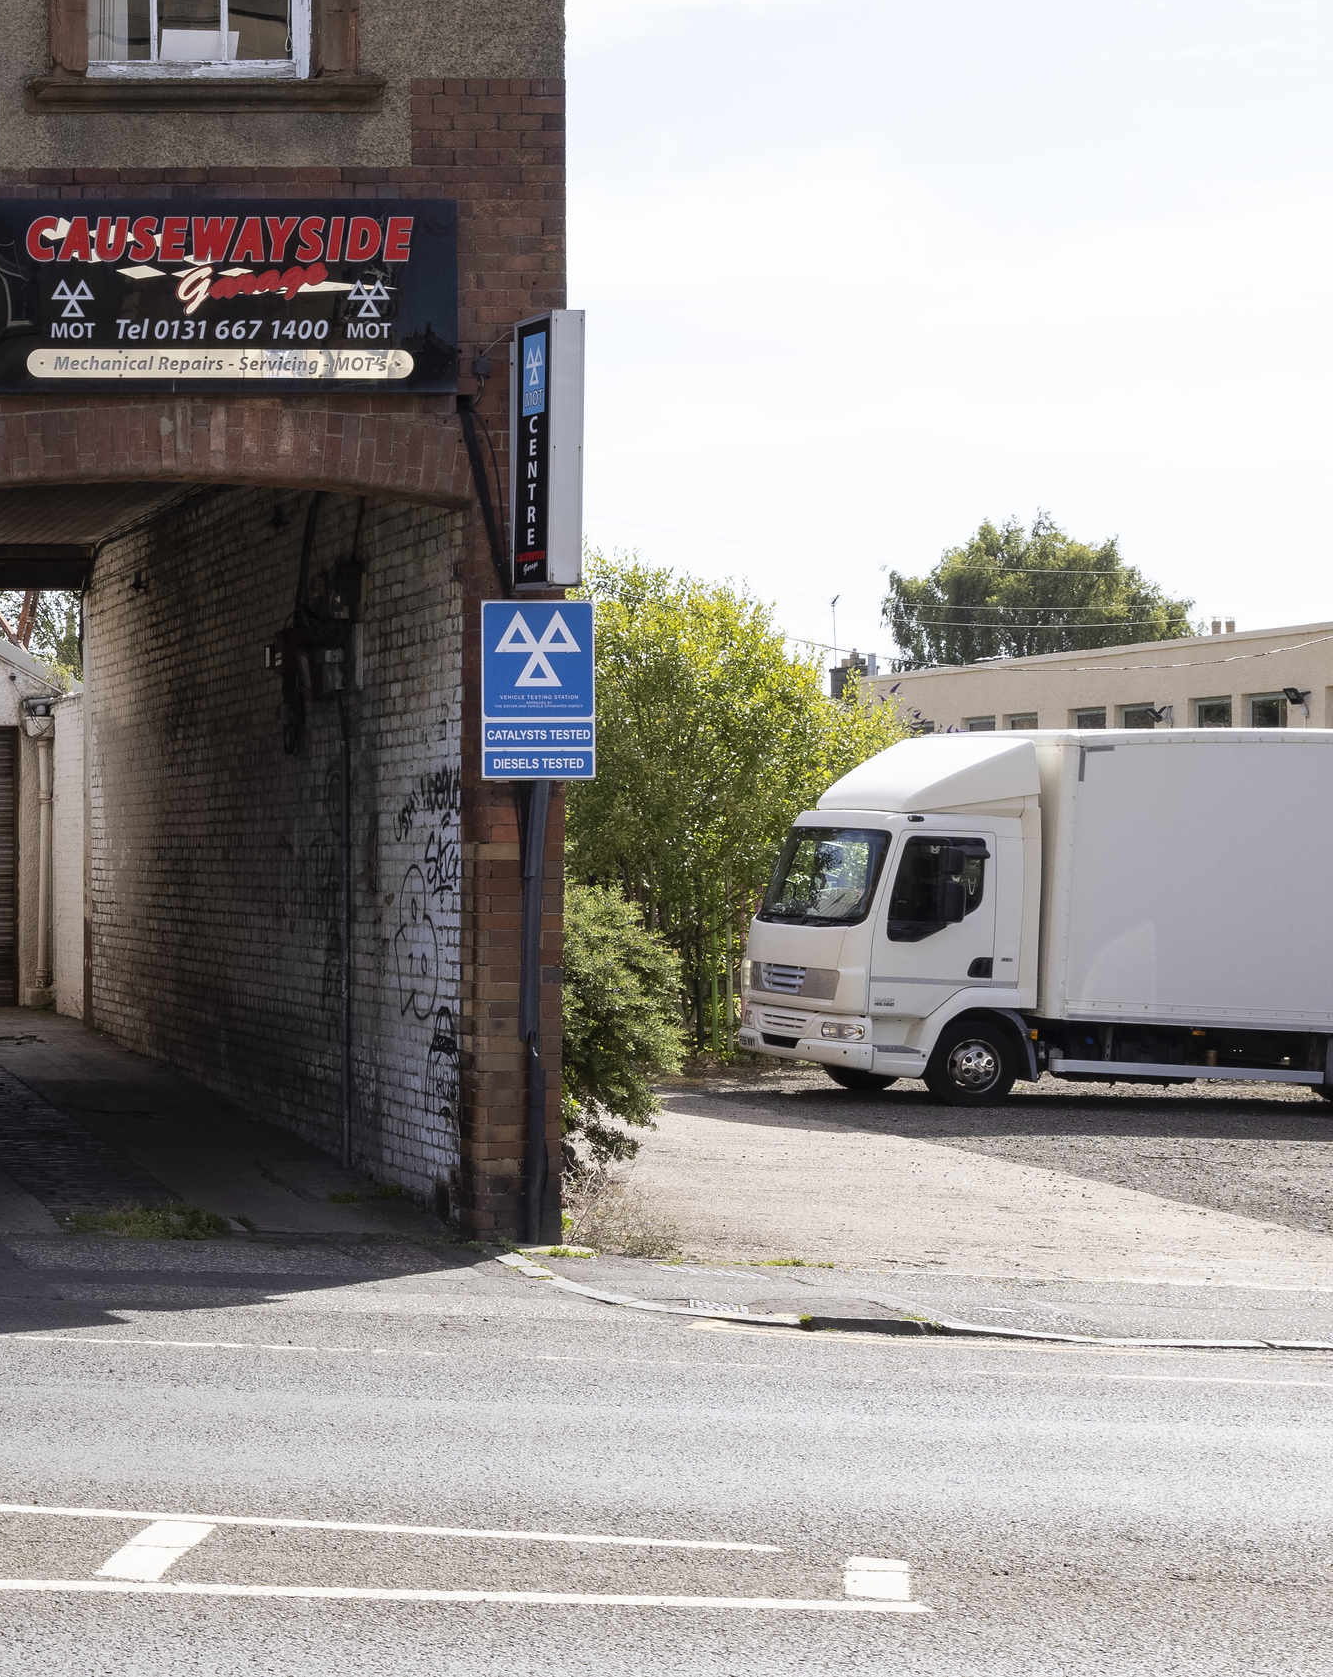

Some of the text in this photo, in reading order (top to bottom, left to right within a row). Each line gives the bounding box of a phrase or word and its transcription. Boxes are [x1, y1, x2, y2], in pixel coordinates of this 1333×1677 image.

[26, 215, 414, 262] CAUSEWAYSIDE
[176, 262, 328, 315] Garage
[51, 322, 95, 339] MOT
[116, 318, 329, 340] Tel 0131 667 1400
[347, 322, 391, 339] MOT
[53, 356, 153, 372] Mechanical
[158, 356, 224, 376] Repairs
[238, 356, 318, 375] Servicing
[334, 356, 387, 372] MOT's
[524, 388, 543, 408] MOT
[526, 415, 538, 546] CENTRE
[487, 729, 590, 741] CATALYSTS TESTED
[493, 757, 584, 770] DIESELS TESTED
